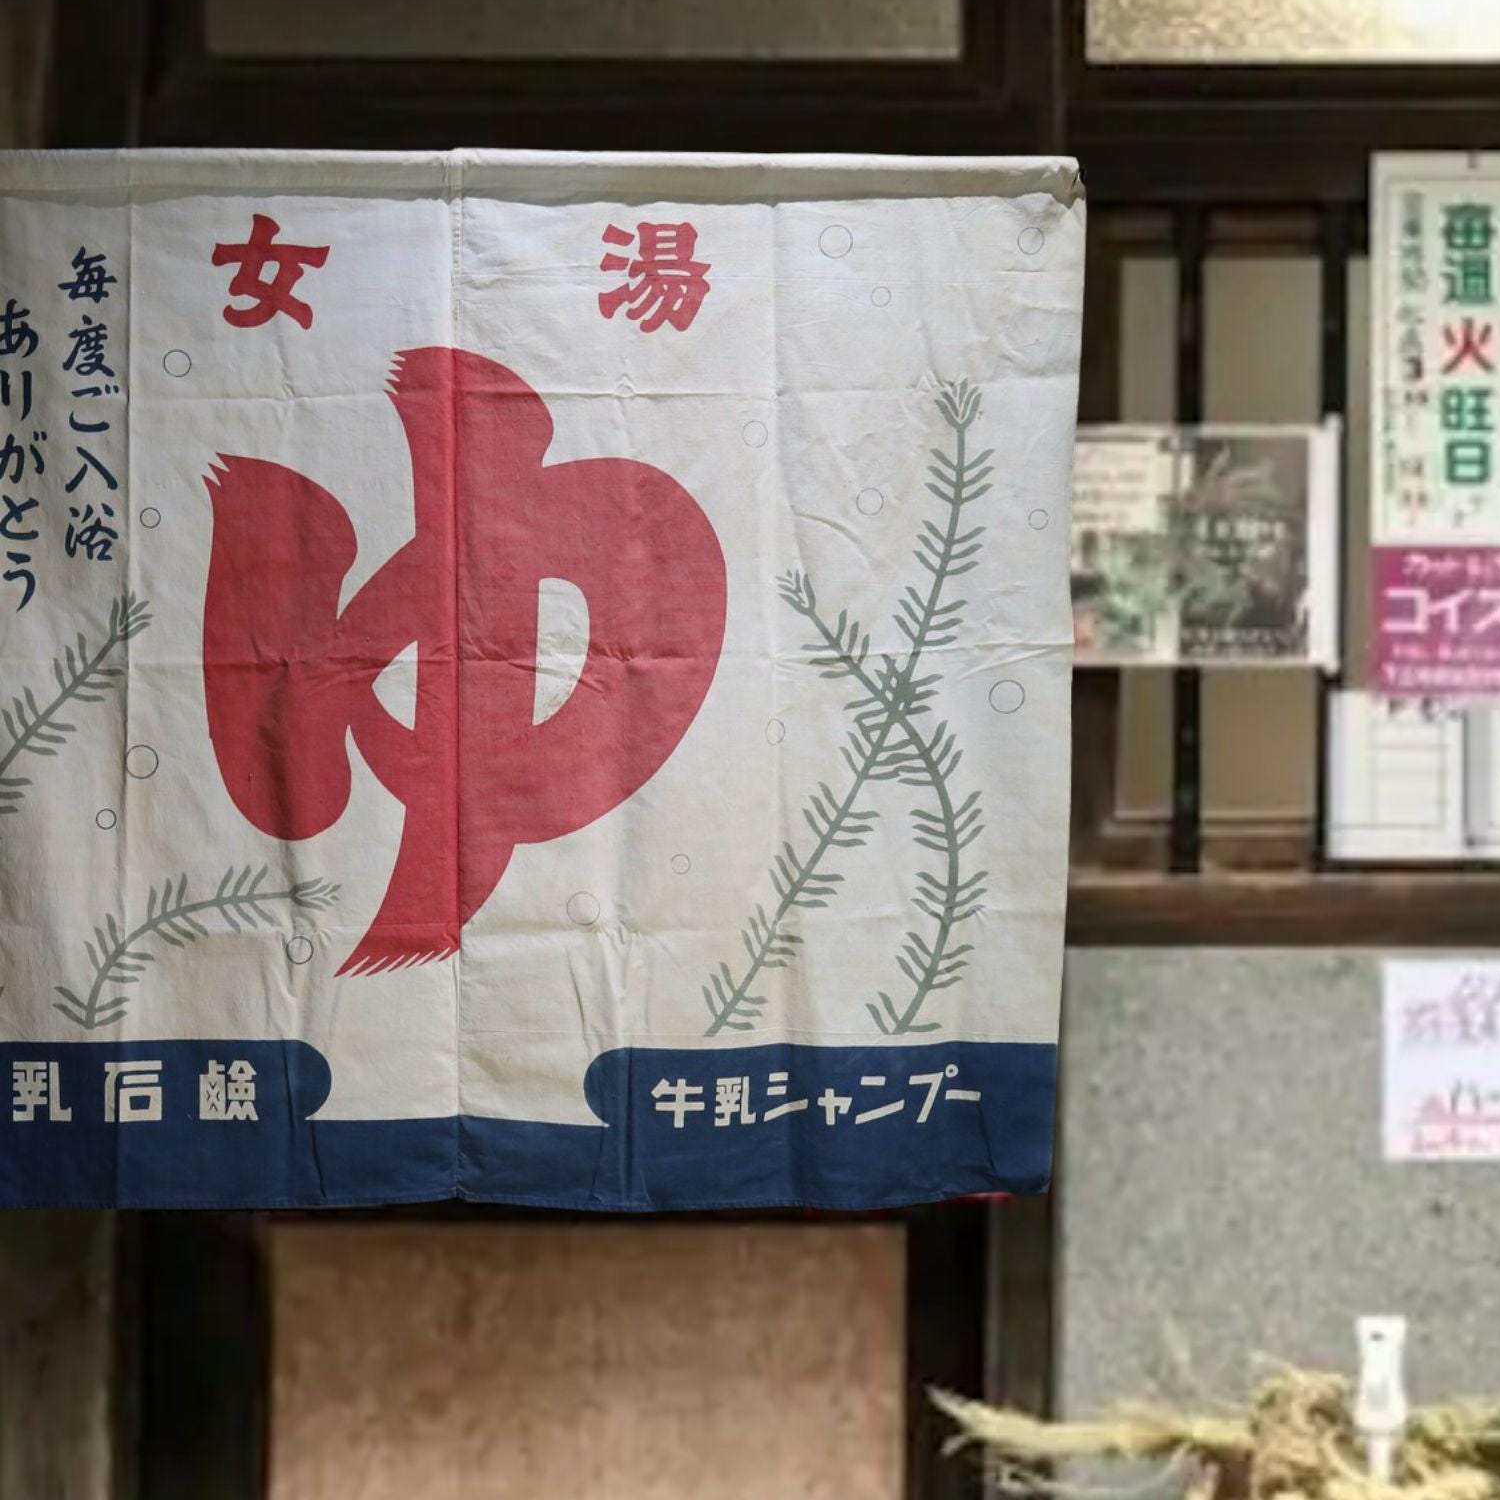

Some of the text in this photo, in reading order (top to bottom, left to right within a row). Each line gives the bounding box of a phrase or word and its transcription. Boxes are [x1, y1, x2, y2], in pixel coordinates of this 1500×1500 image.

[57, 245, 120, 562] 毎度ご入浴
[211, 213, 711, 334] 女 湯
[0, 297, 48, 612] ありがとう
[201, 345, 728, 978] ゆ
[650, 1063, 982, 1129] 牛乳シャンプー
